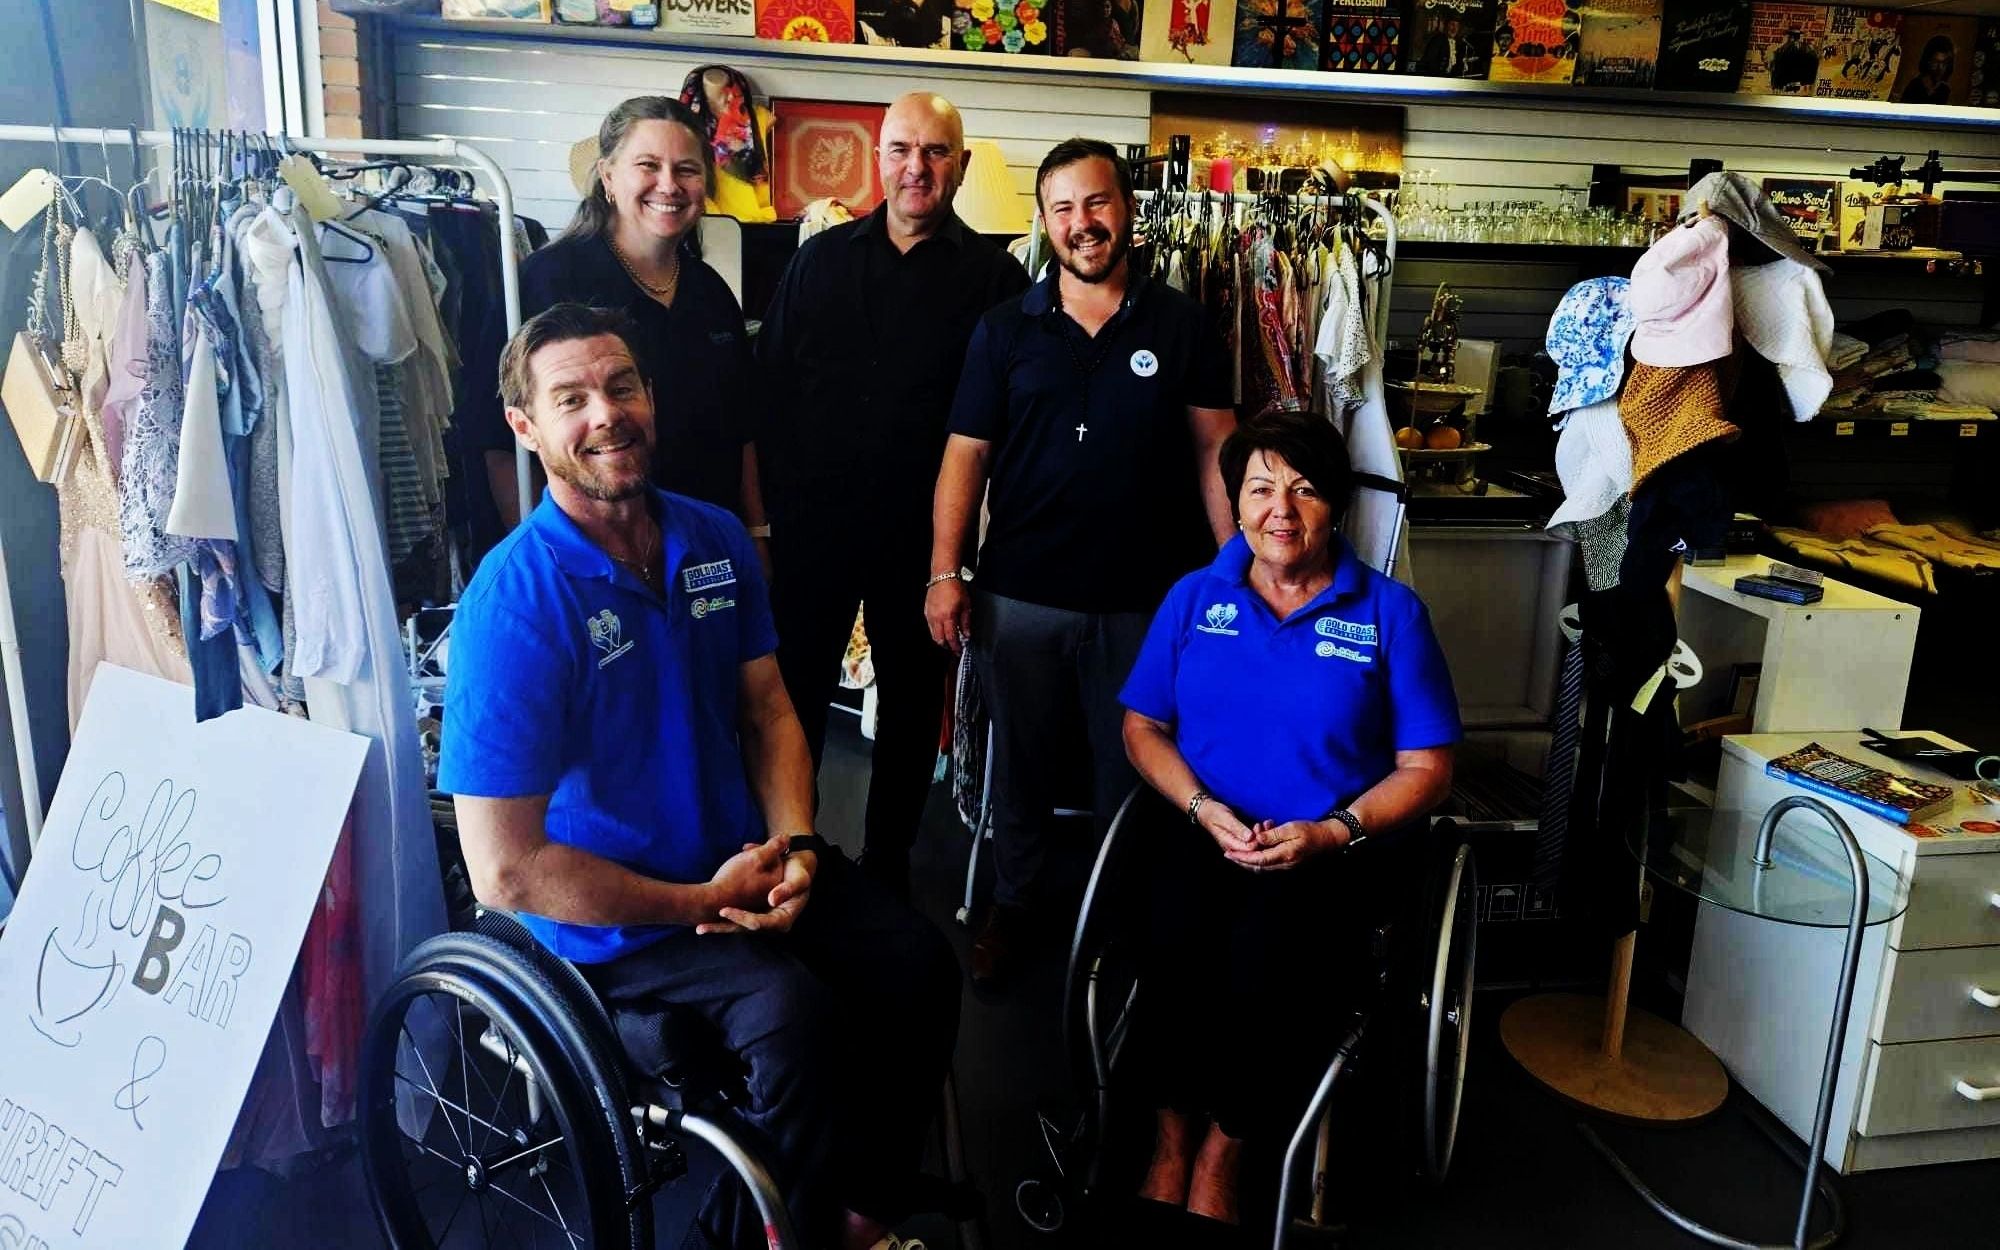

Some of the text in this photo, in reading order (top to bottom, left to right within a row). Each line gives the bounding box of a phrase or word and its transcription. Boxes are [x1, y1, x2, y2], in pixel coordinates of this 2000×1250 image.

[1820, 78, 1832, 88] THE
[1770, 190, 1801, 205] Wave
[1803, 188, 1833, 210] Surf
[1326, 619, 1377, 636] GOLD COAST
[72, 771, 227, 938] Coffee
[131, 904, 252, 1030] BAR
[114, 1035, 167, 1131] &
